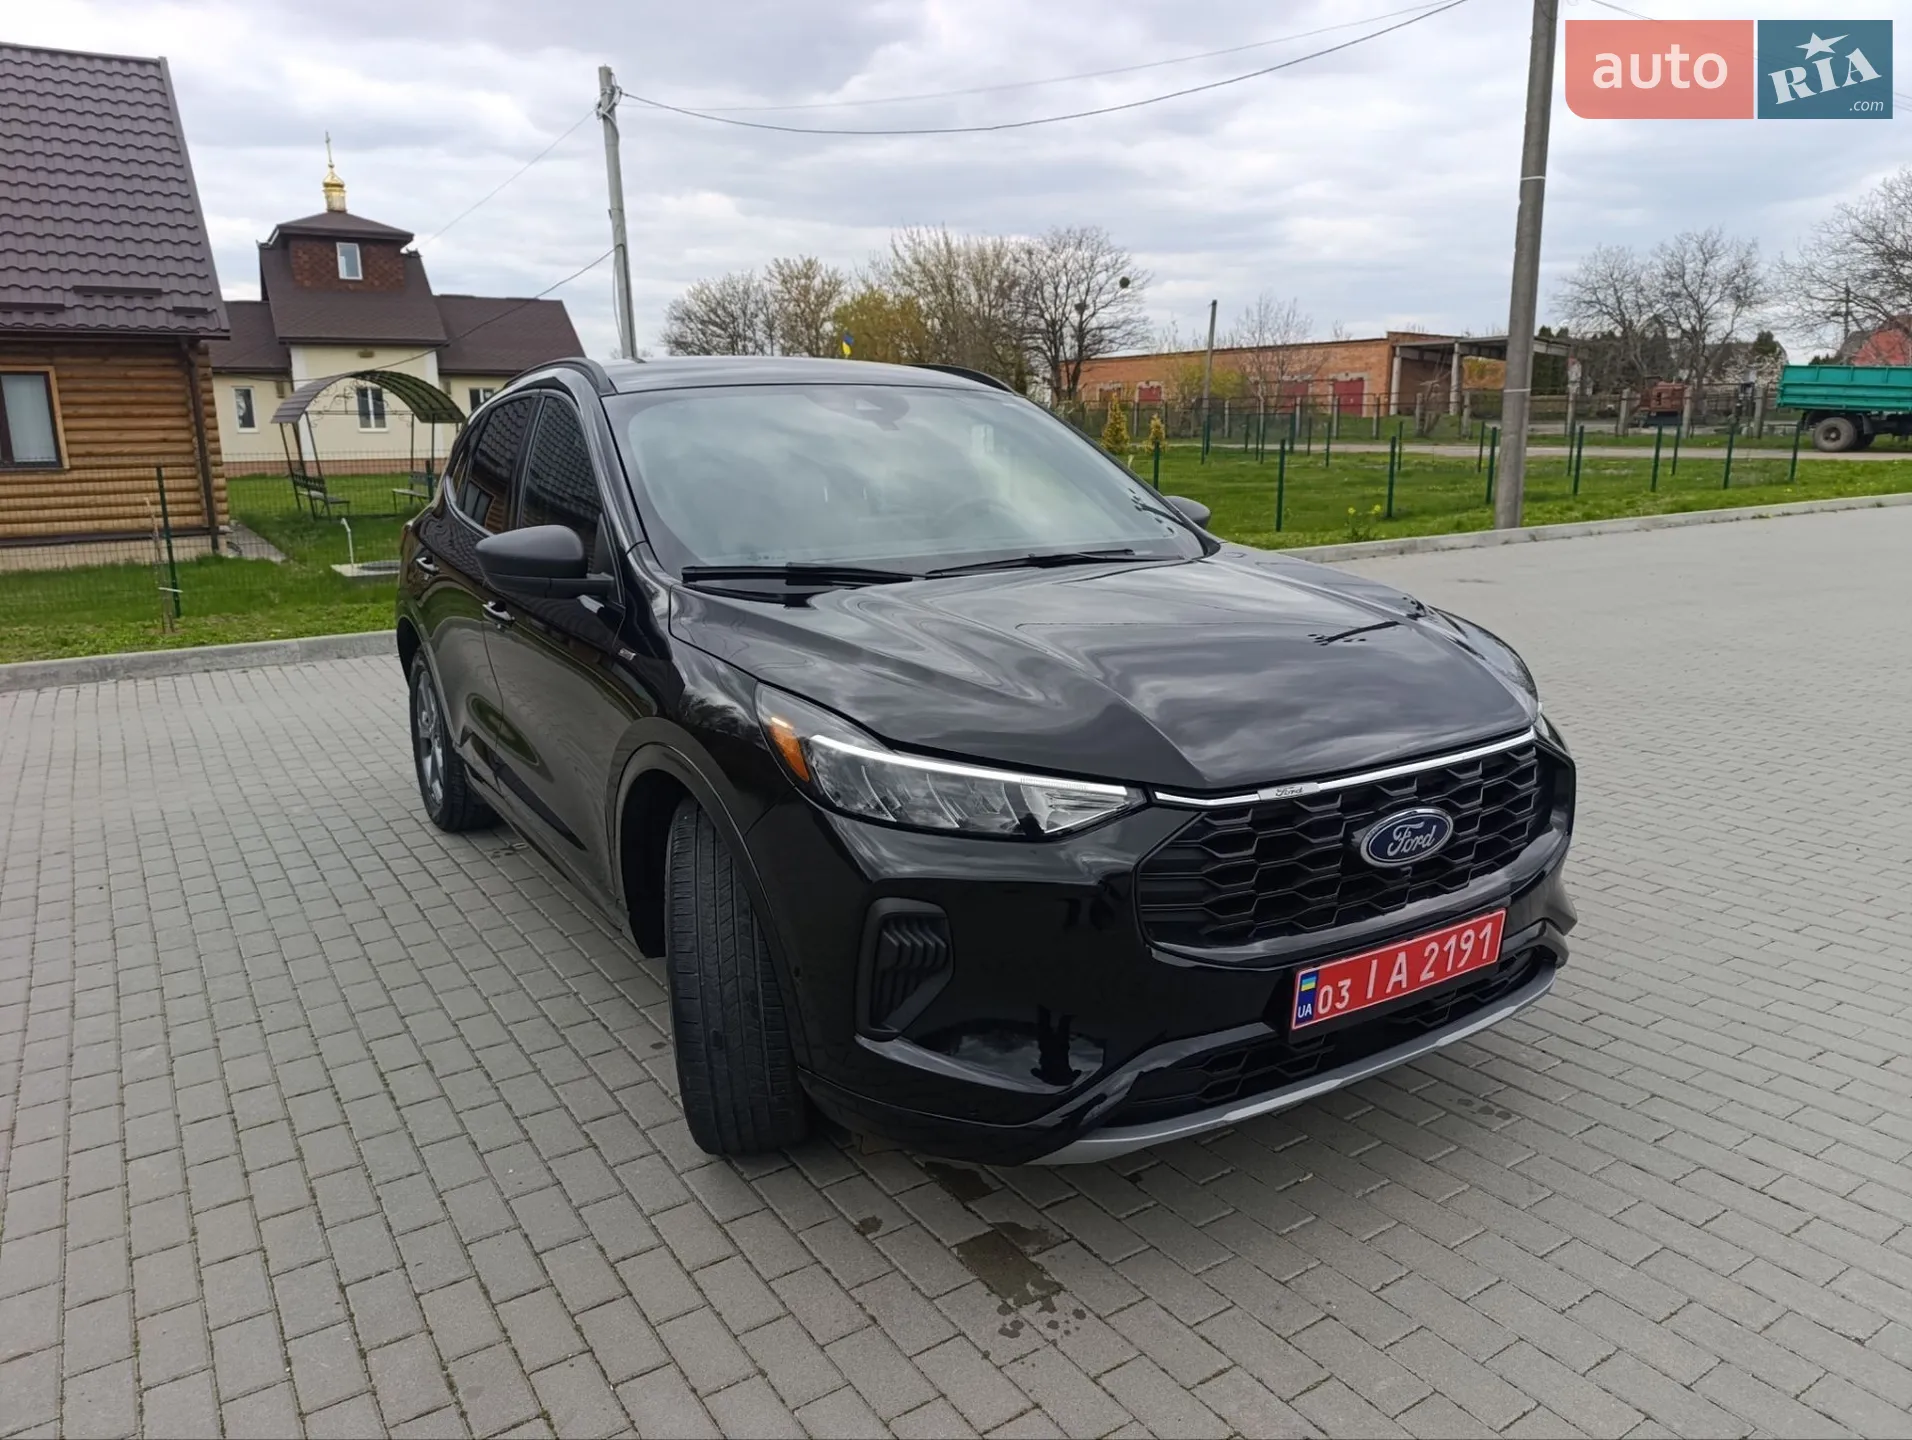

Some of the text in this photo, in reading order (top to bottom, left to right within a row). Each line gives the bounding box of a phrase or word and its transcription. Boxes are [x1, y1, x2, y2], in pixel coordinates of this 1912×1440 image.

[1275, 785, 1303, 797] Ford
[1387, 821, 1437, 857] Ford
[1317, 922, 1493, 1015] 03 IA 2191
[1297, 1003, 1312, 1018] UA
